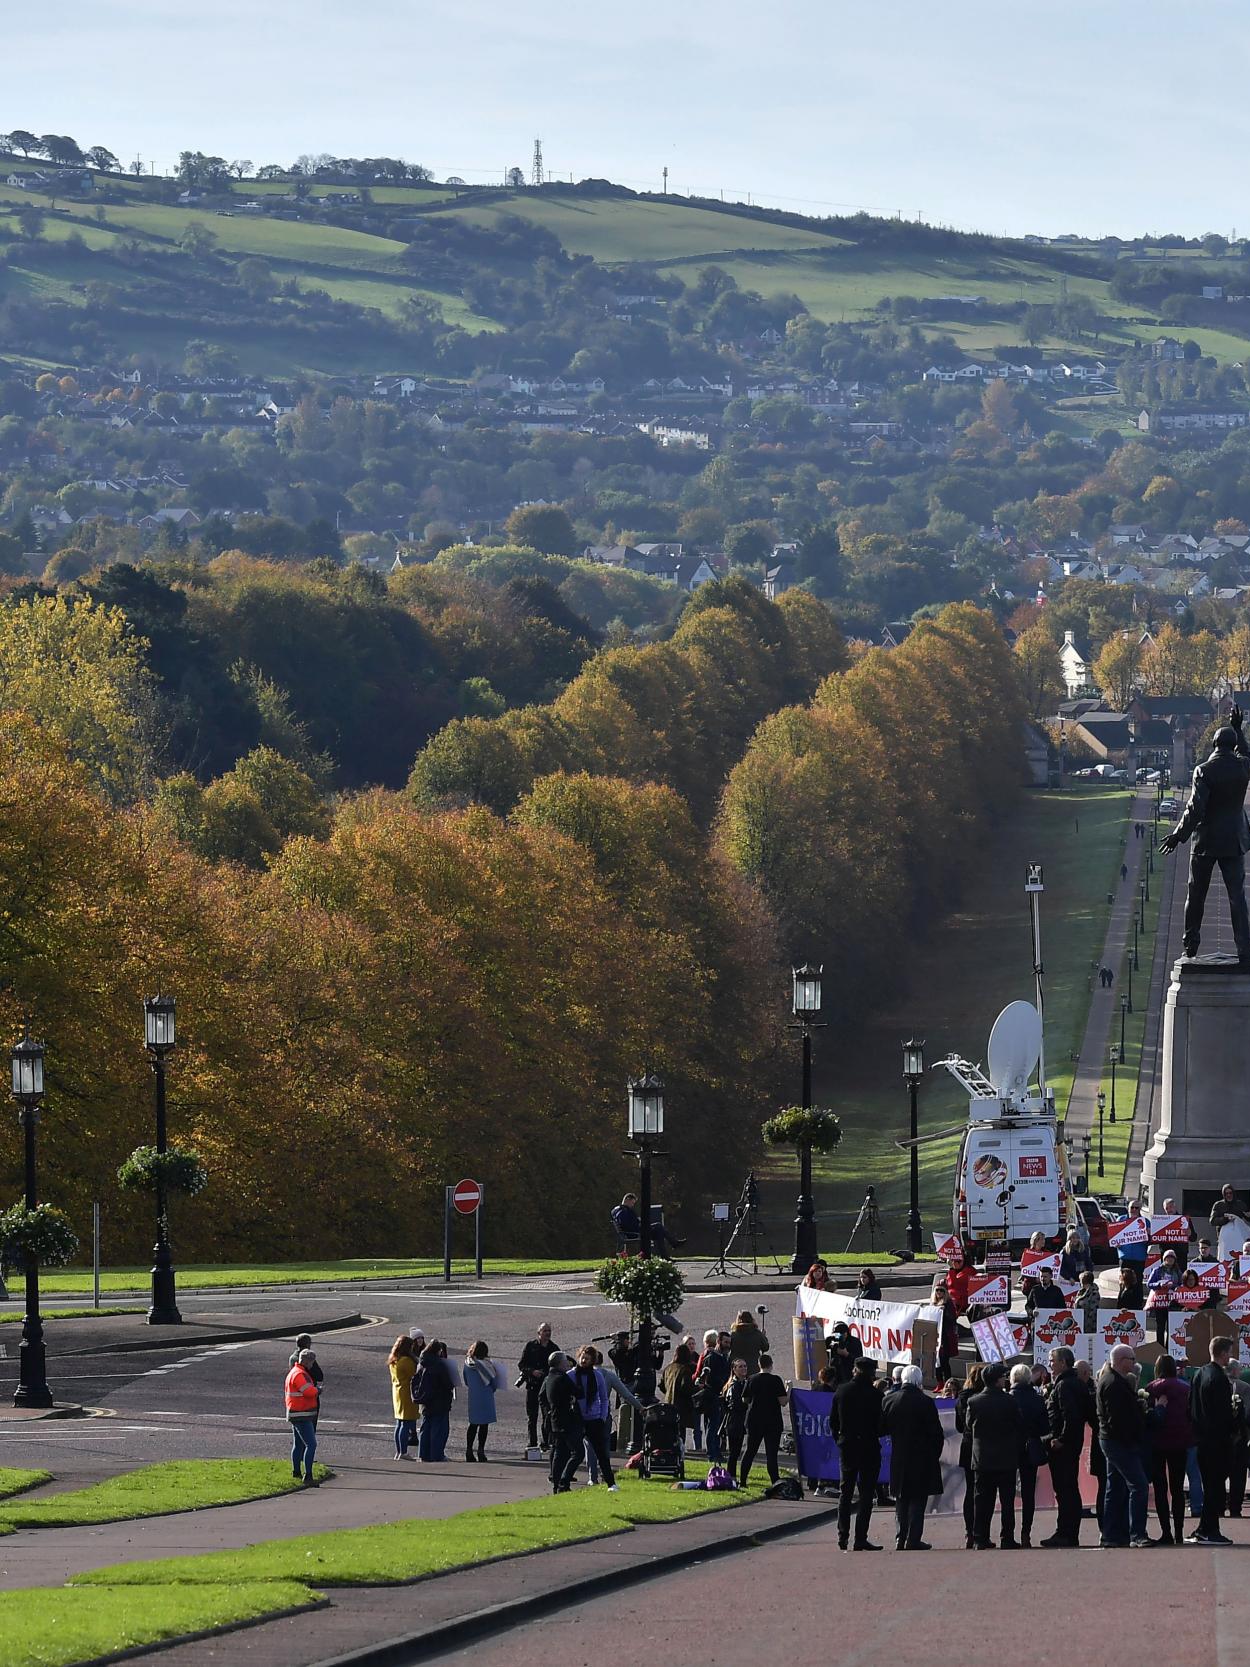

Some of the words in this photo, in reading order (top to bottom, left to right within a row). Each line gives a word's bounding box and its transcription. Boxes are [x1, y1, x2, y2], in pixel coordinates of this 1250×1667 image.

[1022, 1268, 1037, 1276] OUR
[844, 1303, 881, 1321] Abortion?
[848, 1322, 882, 1350] OUR
[887, 1328, 913, 1352] NA
